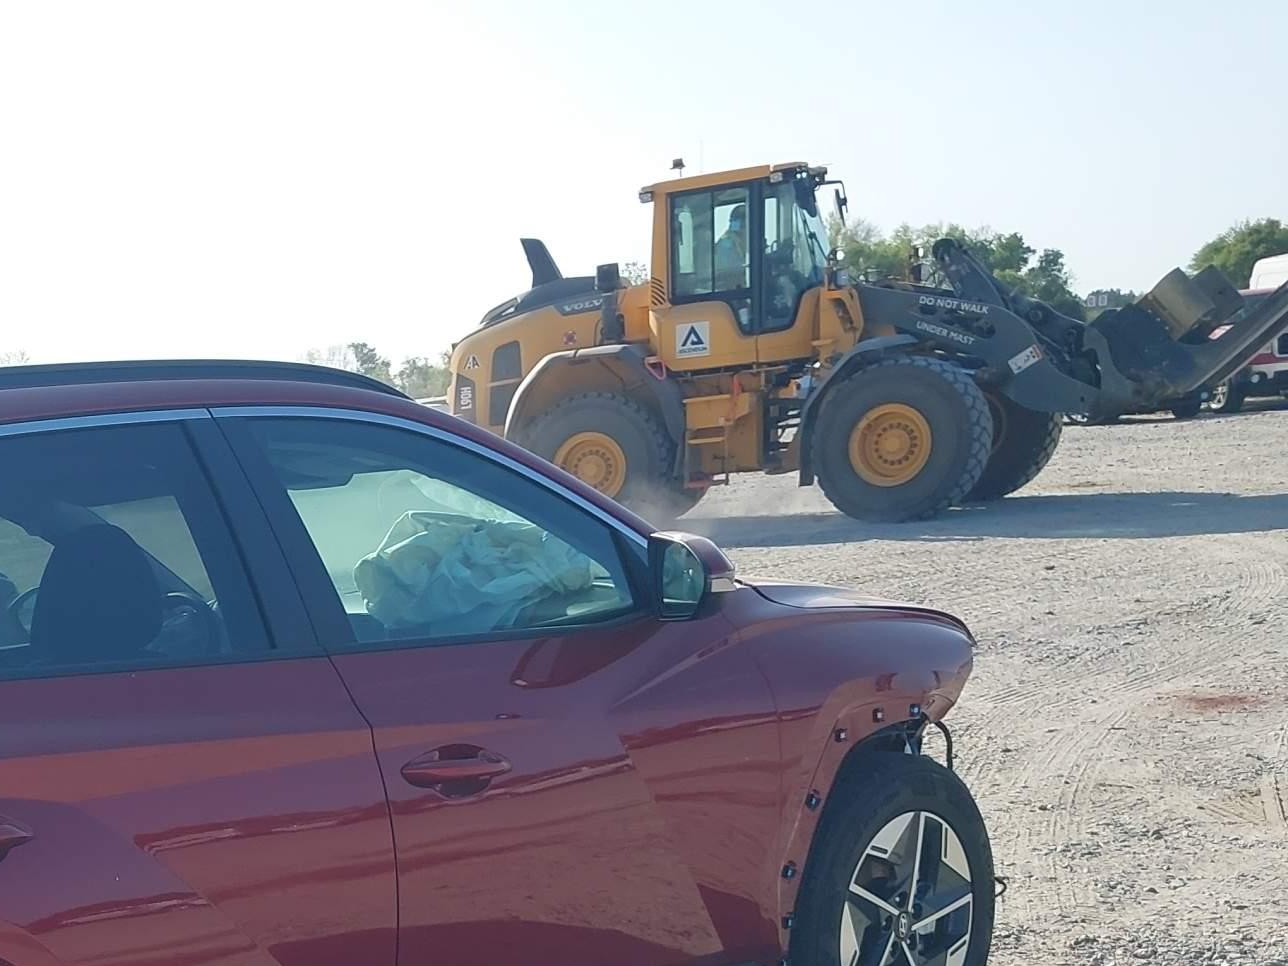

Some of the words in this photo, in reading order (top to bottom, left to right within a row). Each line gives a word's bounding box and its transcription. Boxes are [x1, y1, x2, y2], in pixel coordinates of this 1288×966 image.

[562, 299, 603, 311] VOLV
[919, 296, 935, 305] DO
[936, 299, 959, 309] NOT
[960, 302, 989, 314] WALK
[916, 321, 948, 337] UNDER
[460, 386, 472, 410] L90H
